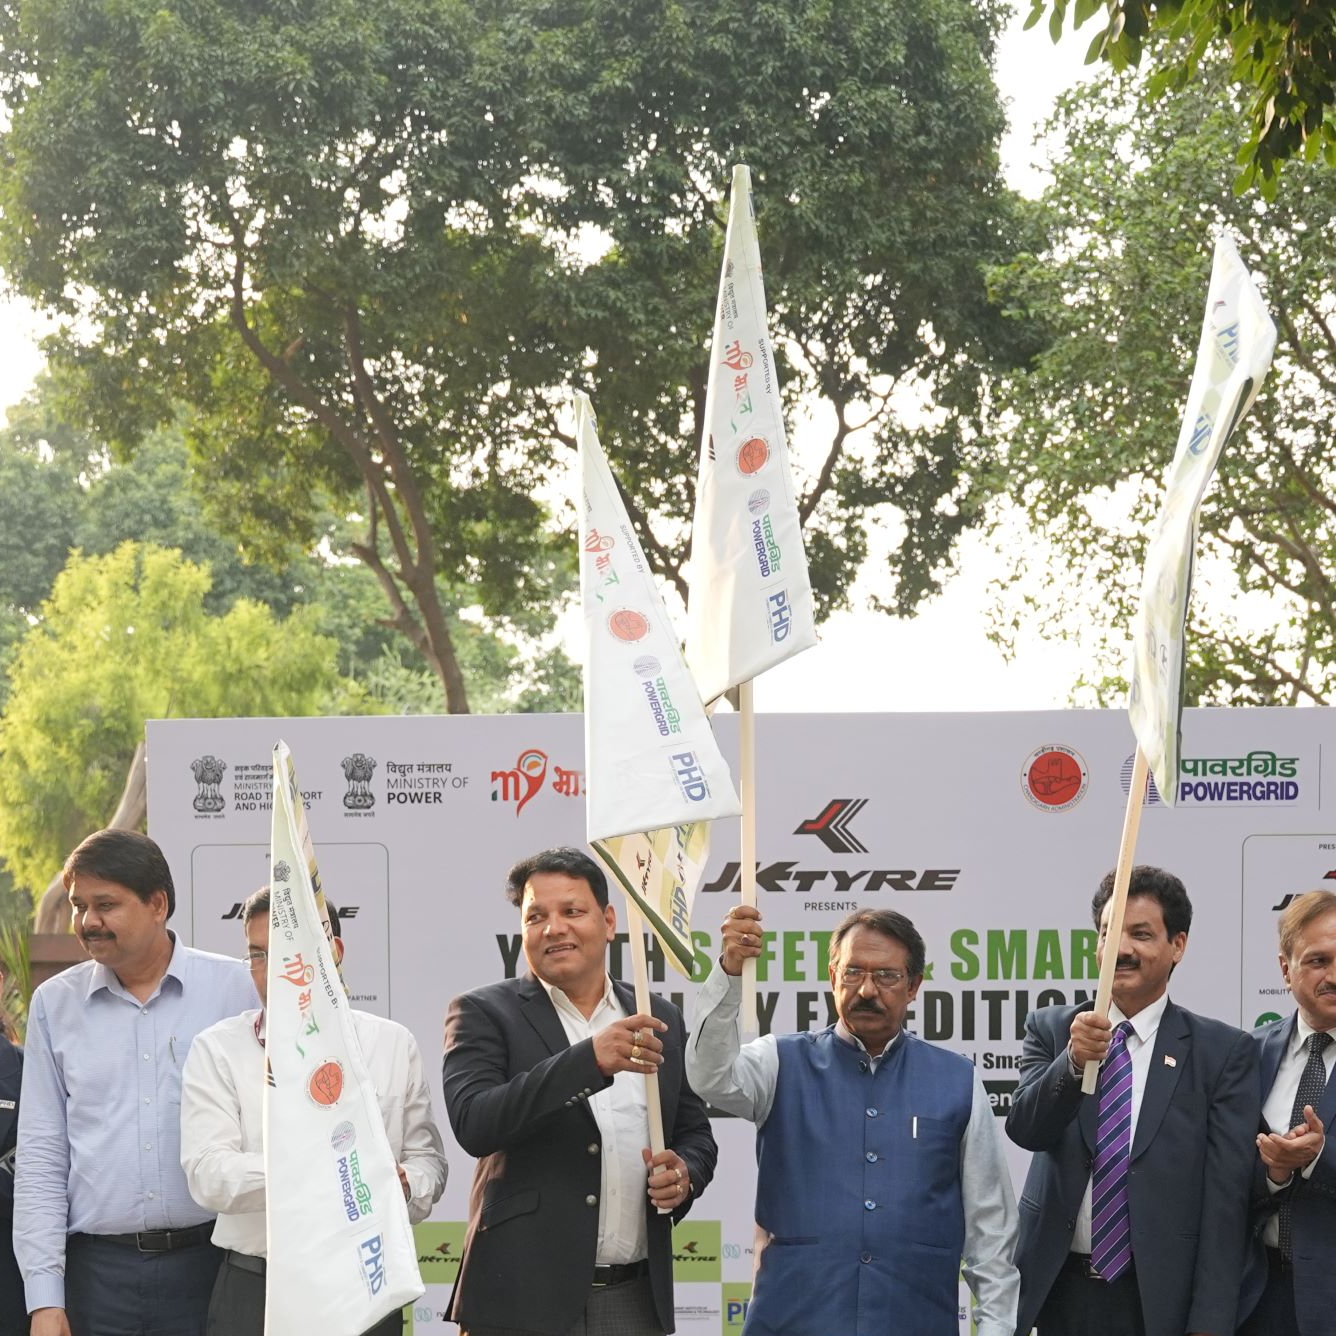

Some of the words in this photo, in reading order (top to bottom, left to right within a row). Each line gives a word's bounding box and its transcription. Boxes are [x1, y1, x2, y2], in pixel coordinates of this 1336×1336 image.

[752, 519, 771, 578] POWERGRID
[769, 590, 790, 643] PHD
[642, 680, 670, 737] POWERGRID
[386, 762, 414, 777] विद्युत
[417, 761, 452, 774] मंत्रालय
[386, 777, 448, 789] MINISTRY
[451, 776, 469, 788] OF
[671, 751, 707, 803] PHD
[234, 792, 262, 800] ROAD
[235, 802, 257, 810] AND
[386, 791, 443, 804] POWER
[1180, 781, 1299, 801] POWERGRID
[671, 886, 690, 940] PHD
[804, 901, 859, 911] PRESENTS
[284, 930, 295, 942] OF
[950, 928, 1100, 981] SMAR
[336, 1156, 361, 1222] POWERGRID
[349, 1149, 373, 1216] पावरग्रिड
[361, 1235, 385, 1296] PHD
[418, 1255, 461, 1263] JKTYR
